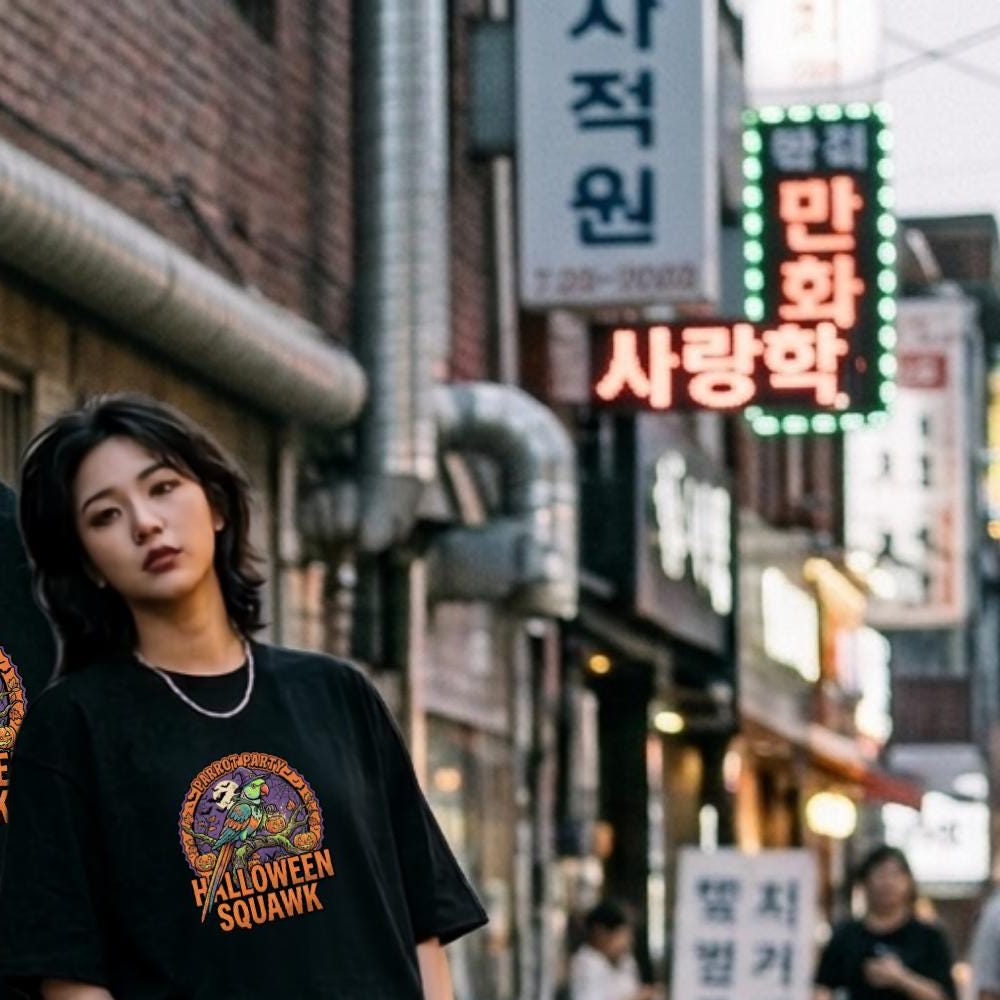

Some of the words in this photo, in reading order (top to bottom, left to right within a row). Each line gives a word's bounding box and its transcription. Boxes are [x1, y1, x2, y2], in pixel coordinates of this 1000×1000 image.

[596, 323, 849, 409] 사랑학
[194, 754, 238, 792] PARROT
[243, 753, 286, 774] PARTY
[191, 849, 335, 907] HALLOWEEN
[217, 883, 324, 932] SQUAWK
